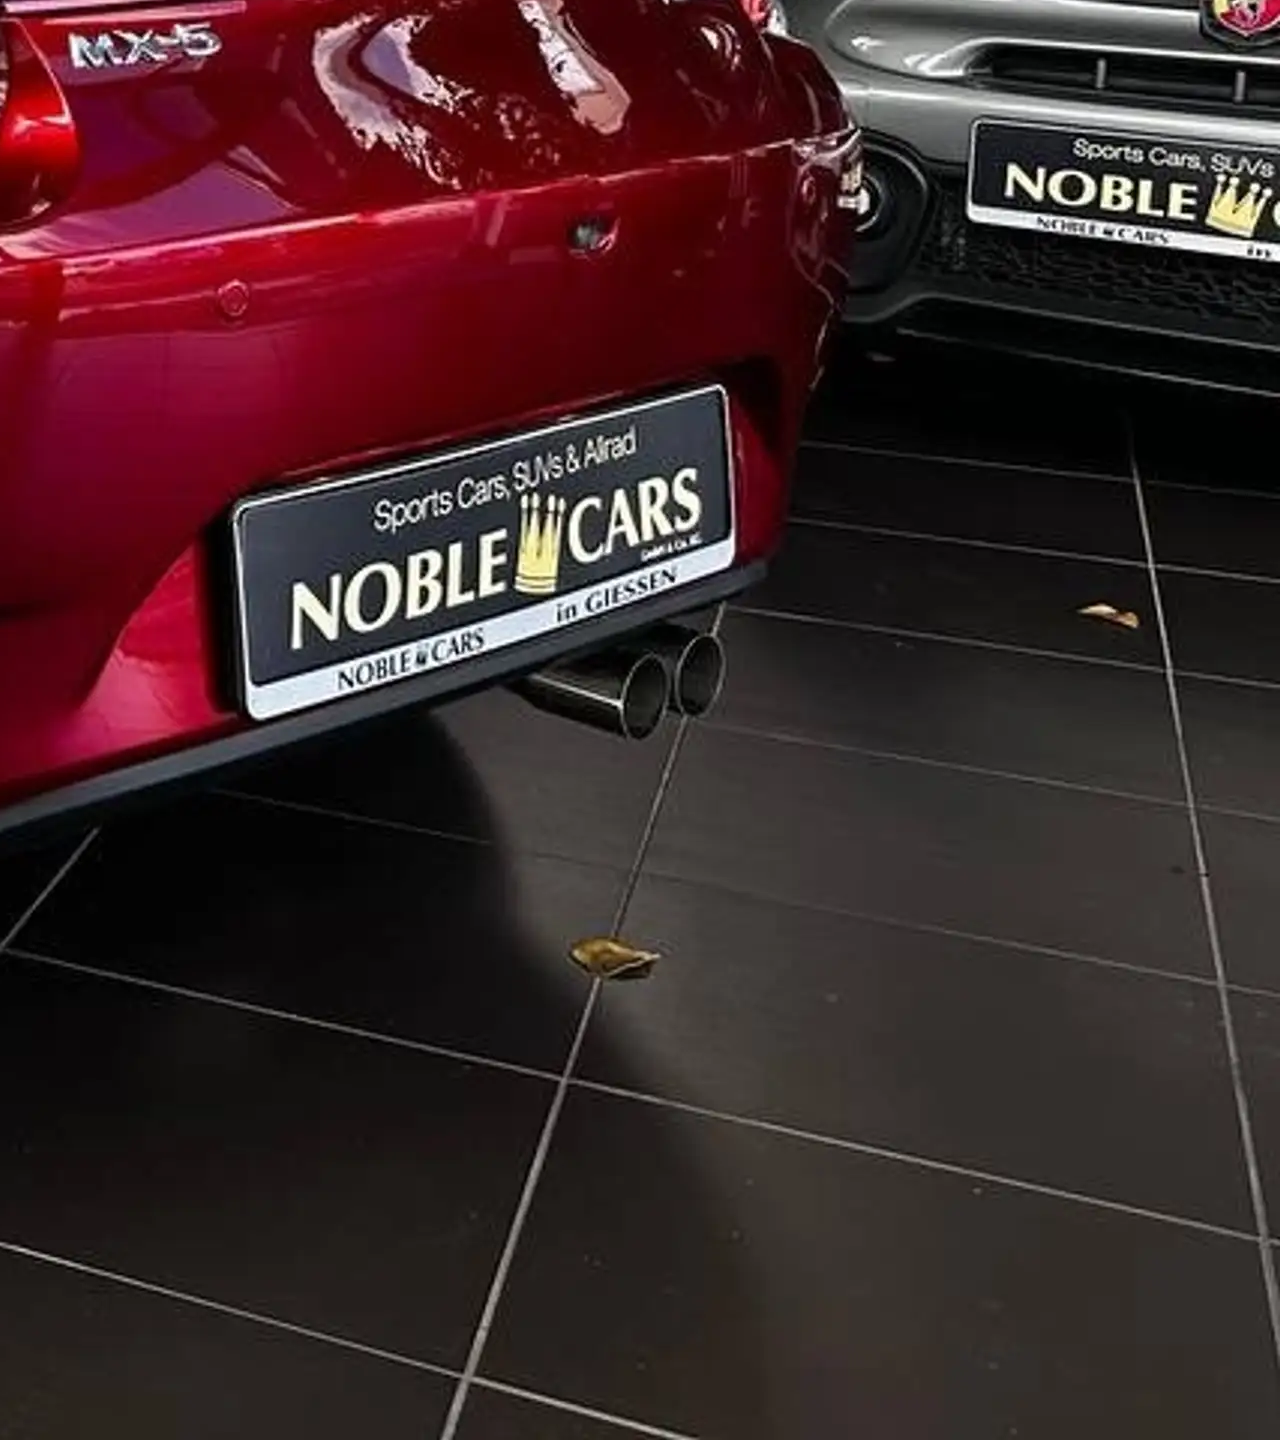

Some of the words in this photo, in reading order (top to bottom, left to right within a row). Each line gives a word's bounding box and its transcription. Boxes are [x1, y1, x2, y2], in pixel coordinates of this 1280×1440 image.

[68, 21, 222, 69] MX-5
[1003, 162, 1199, 222] NOBLE
[1072, 137, 1144, 162] Sports
[1210, 152, 1275, 178] SUVs
[372, 487, 453, 534] Sports
[457, 473, 510, 510] Cars,
[512, 453, 564, 491] SUVs
[565, 443, 582, 473] &
[584, 427, 637, 469] Allrad
[291, 528, 508, 650] NOBLE
[568, 467, 703, 563] CARS
[338, 647, 411, 690] NOBLE
[431, 627, 484, 663] CARS
[556, 598, 578, 623] in
[583, 564, 679, 613] GIESSEN
